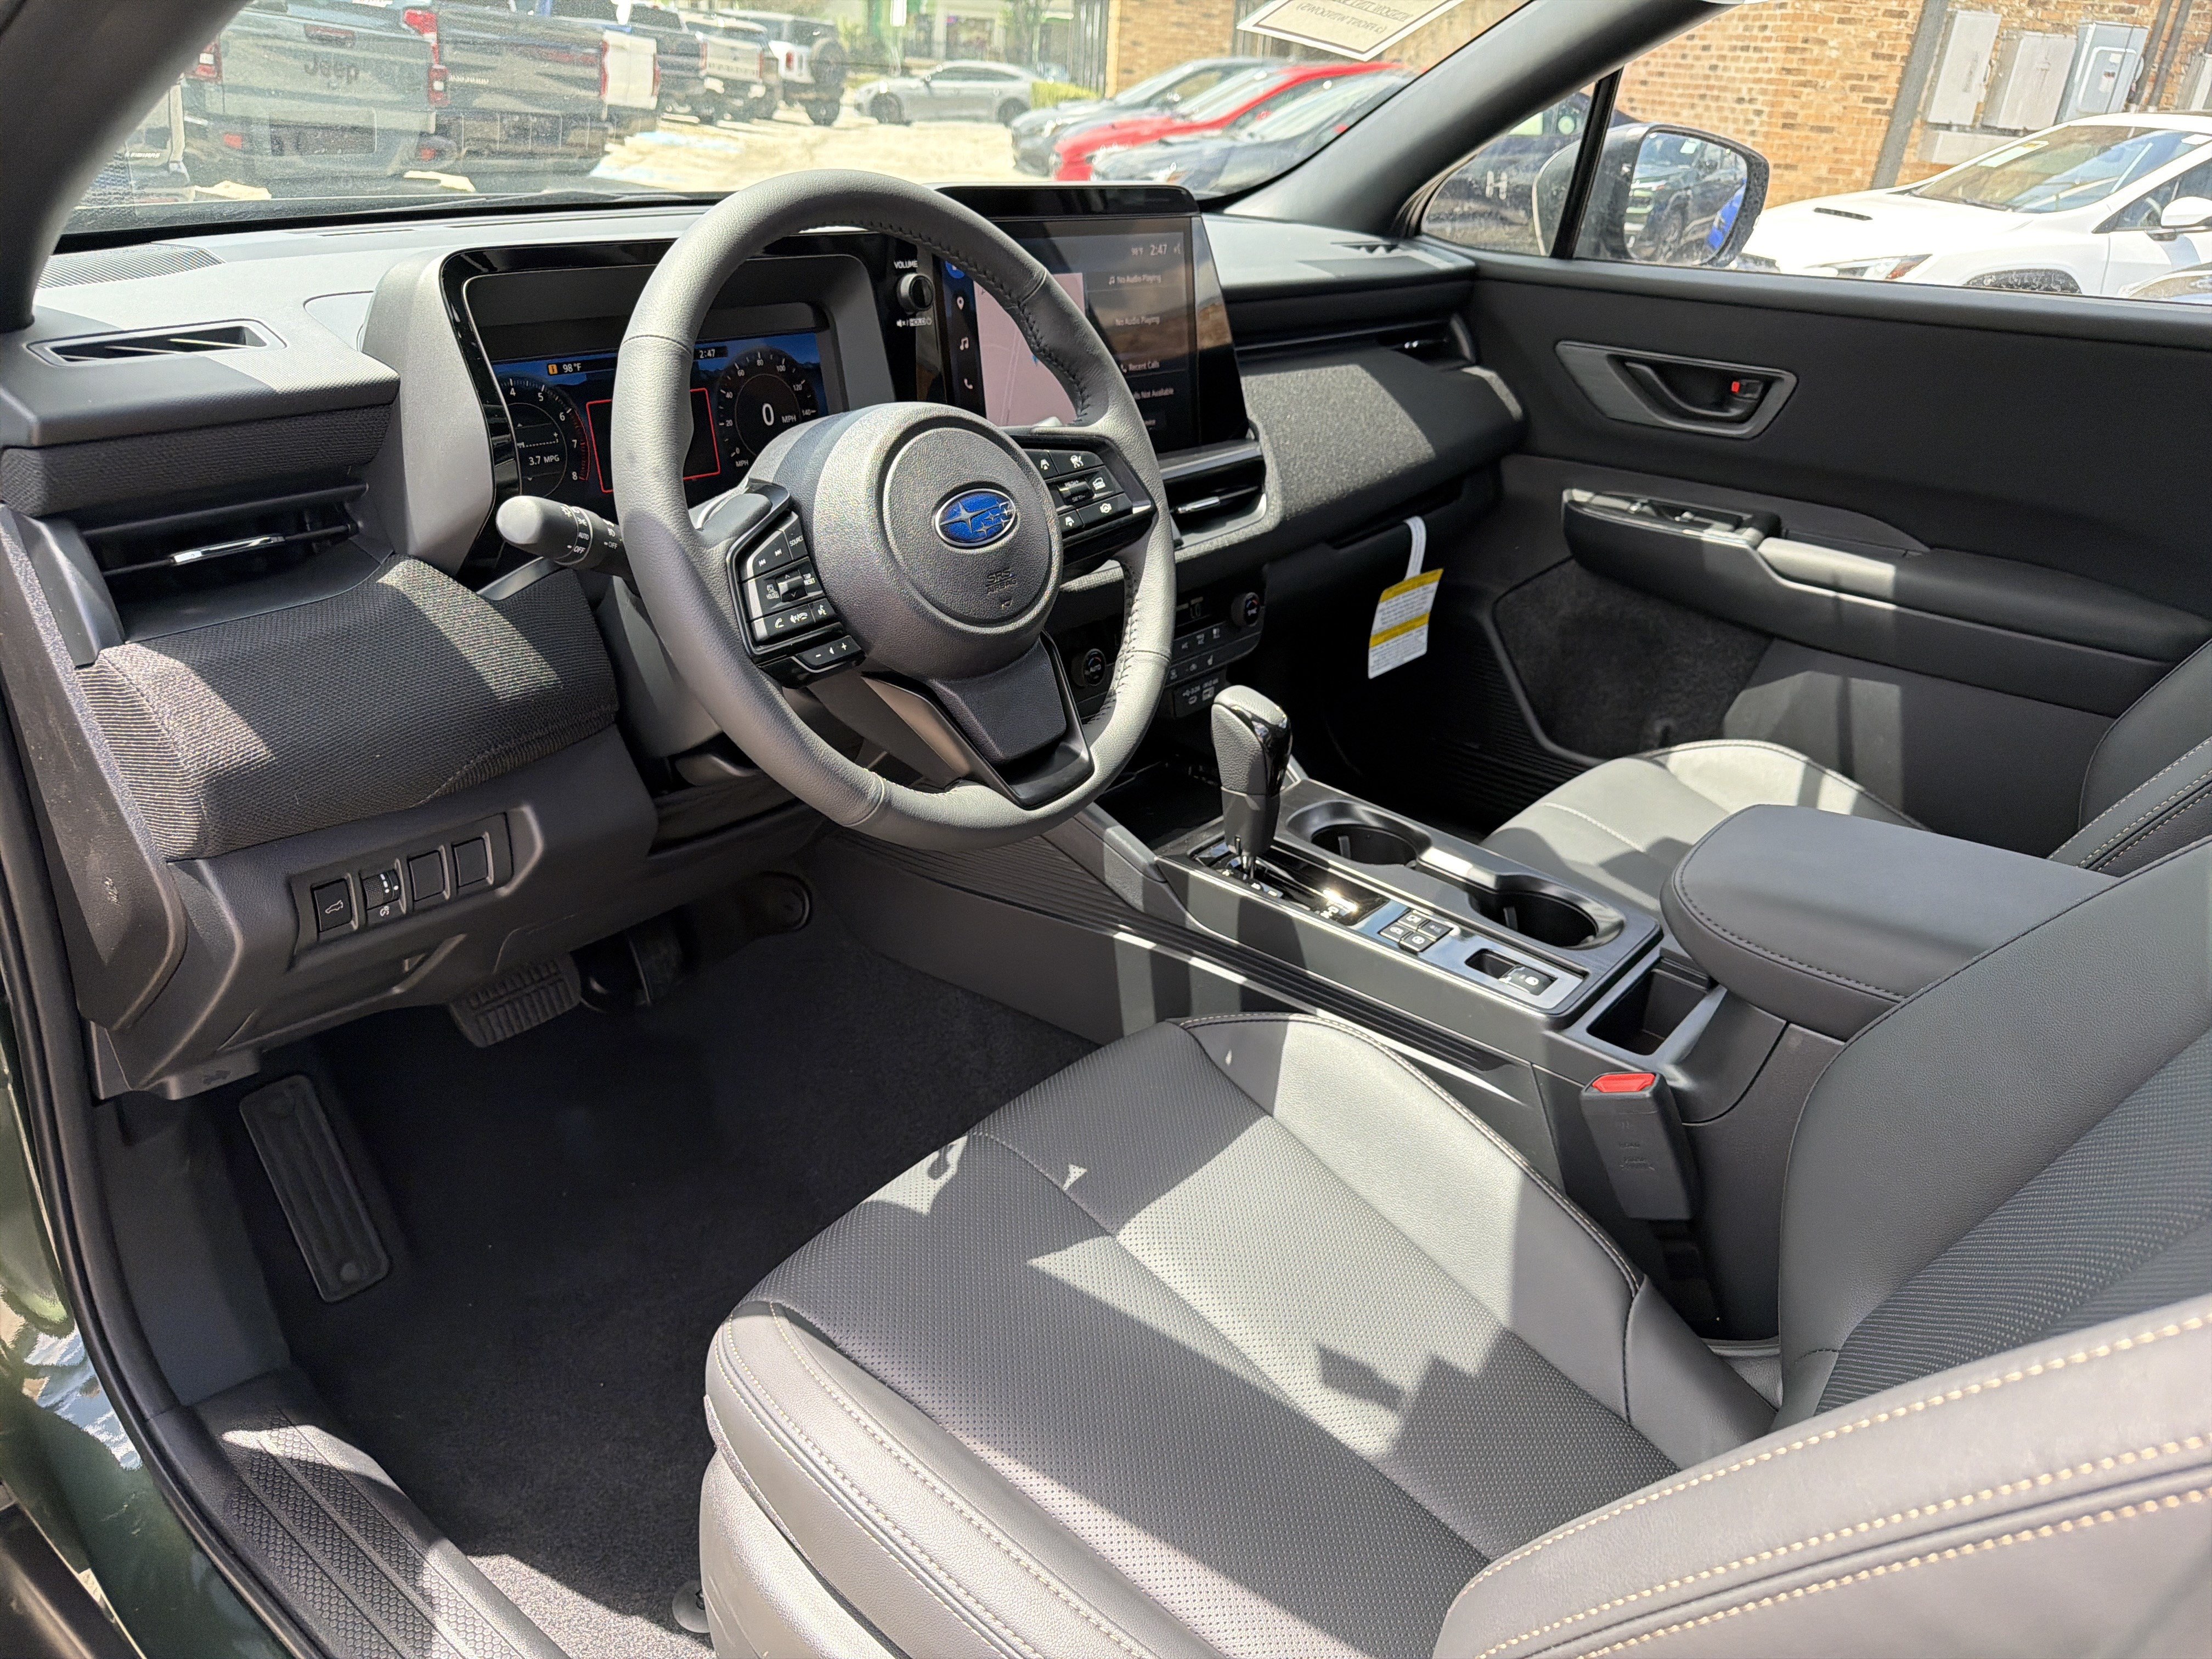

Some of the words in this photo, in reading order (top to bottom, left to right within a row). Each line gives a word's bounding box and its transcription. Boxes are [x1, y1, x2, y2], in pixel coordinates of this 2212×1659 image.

[304, 55, 360, 84] Jeep
[1150, 244, 1167, 256] 2:47
[893, 259, 918, 269] VOLUME
[699, 348, 715, 359] 2:47
[510, 387, 516, 396] 4
[538, 392, 544, 402] 5
[559, 411, 566, 421] 6
[762, 403, 774, 426] 0
[781, 414, 797, 424] MPH
[572, 439, 577, 449] 7
[528, 455, 541, 466] 3.7
[543, 454, 560, 464] MPG
[572, 471, 578, 481] 8
[578, 532, 590, 540] AUTO
[789, 534, 804, 547] SOURC
[573, 546, 586, 554] OFF
[608, 541, 618, 550] OFF
[987, 568, 1012, 586] SRS
[987, 578, 1019, 595] AIRBAG
